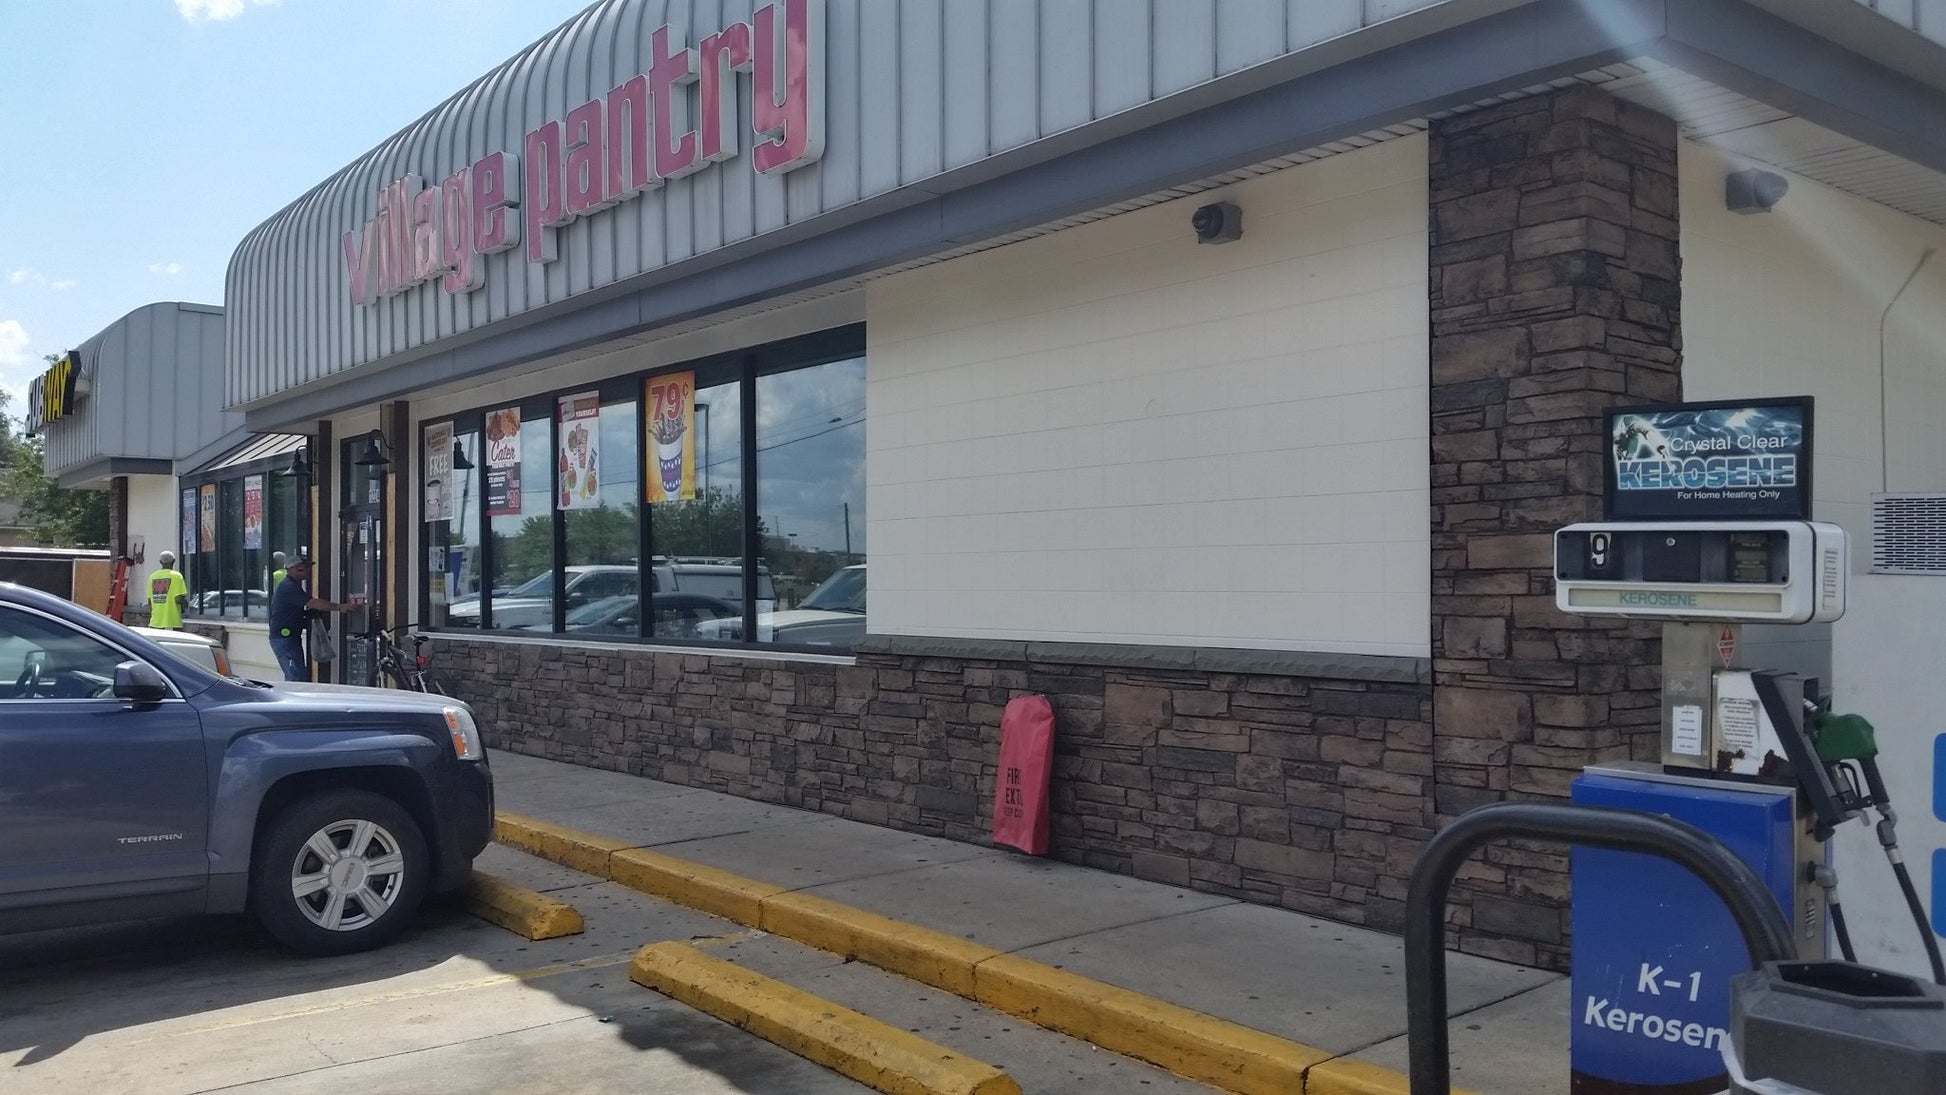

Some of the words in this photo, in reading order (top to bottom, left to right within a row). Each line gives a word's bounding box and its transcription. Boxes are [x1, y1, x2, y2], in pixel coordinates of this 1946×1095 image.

[343, 151, 515, 306] village
[525, 0, 813, 265] pantry
[25, 354, 72, 434] SUBWAY
[1670, 436, 1731, 454] Crystal
[1737, 434, 1787, 449] Clear
[430, 453, 449, 476] FREE
[1618, 454, 1796, 490] KEROSENE
[1677, 491, 1692, 500] For
[1695, 491, 1720, 499] Home
[1722, 490, 1756, 500] Heating
[1759, 490, 1780, 499] Only
[1620, 591, 1697, 607] KEROSENE
[118, 833, 183, 844] TERRAIN
[1637, 962, 1702, 1002] K-1
[1584, 995, 1728, 1051] Kerosen
